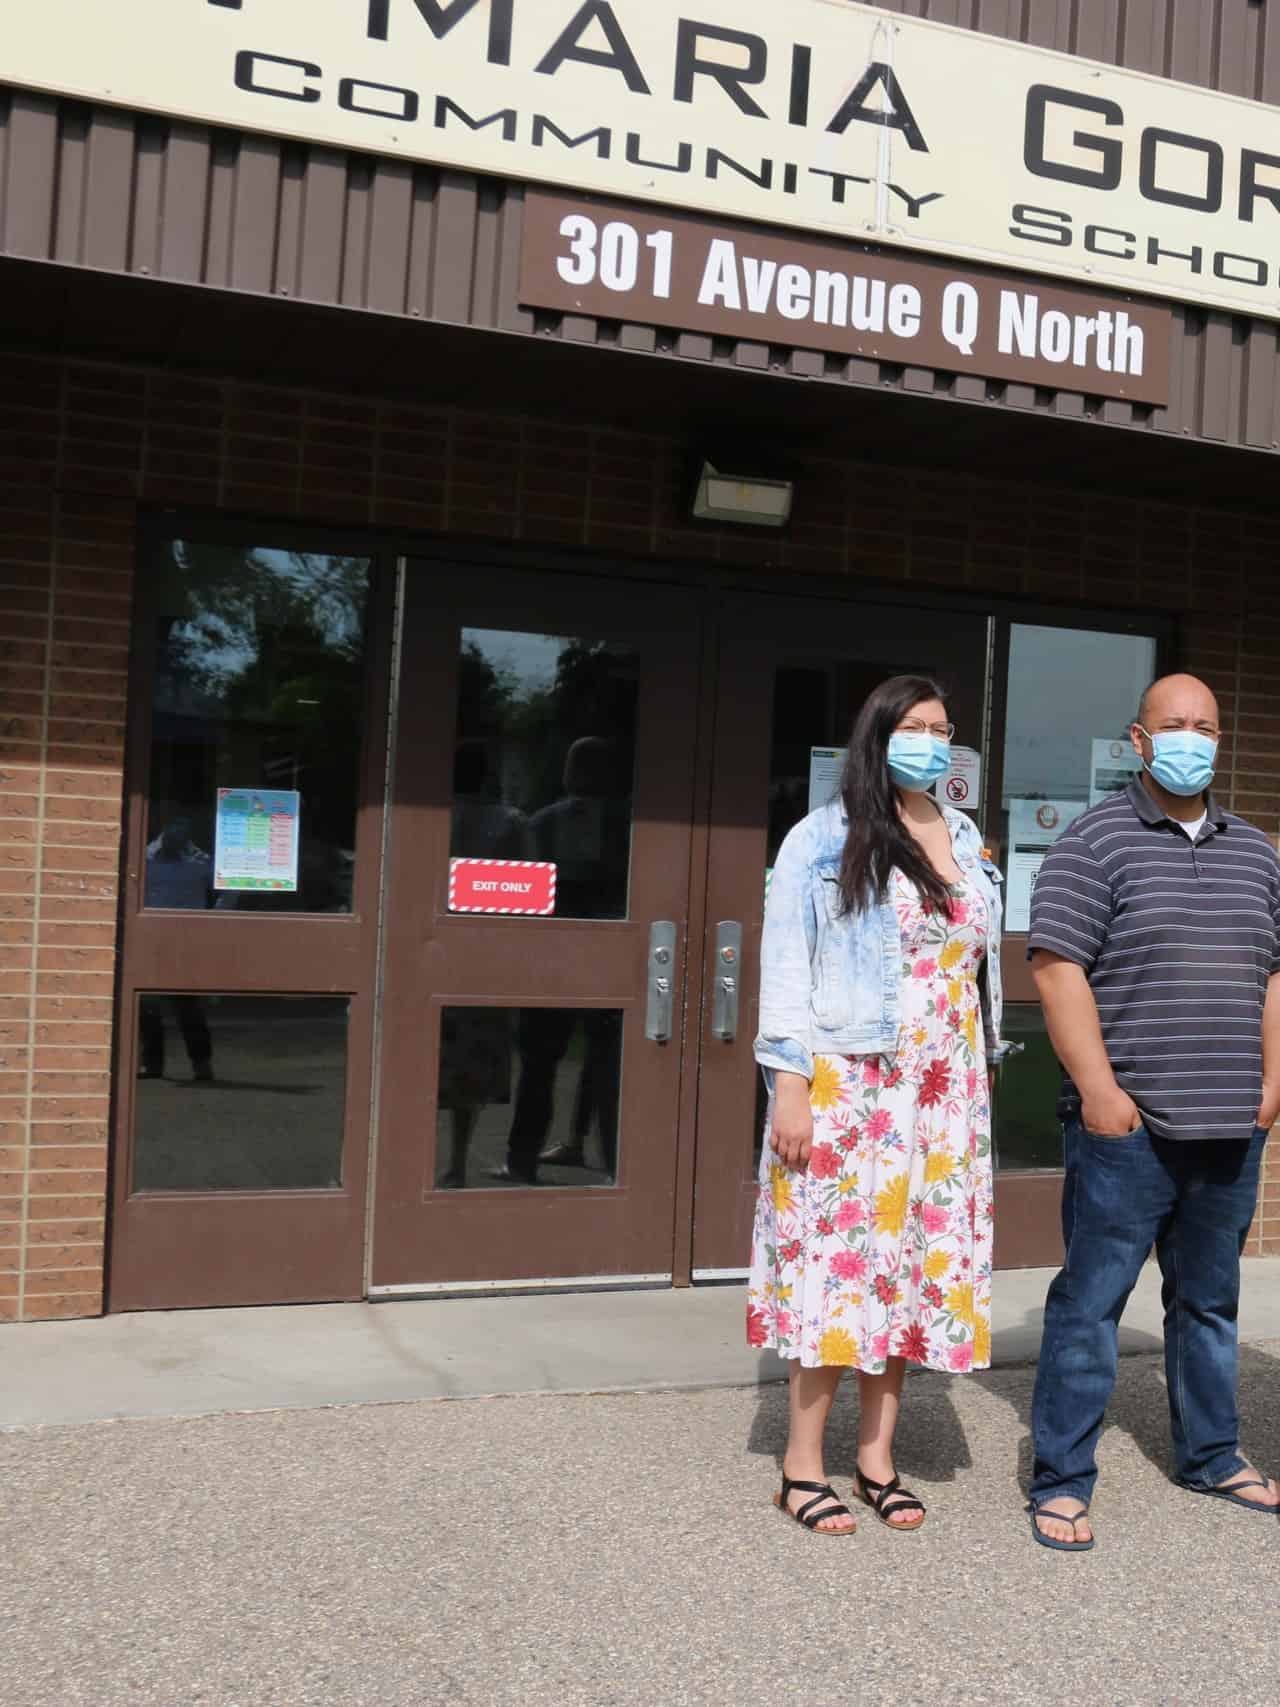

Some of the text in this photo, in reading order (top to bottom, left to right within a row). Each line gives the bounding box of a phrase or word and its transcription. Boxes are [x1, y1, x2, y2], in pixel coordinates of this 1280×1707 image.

[234, 50, 942, 218] COMMUNITY
[557, 214, 1144, 376] 301 Avenue Q North
[471, 880, 533, 893] EXIT ONLY
